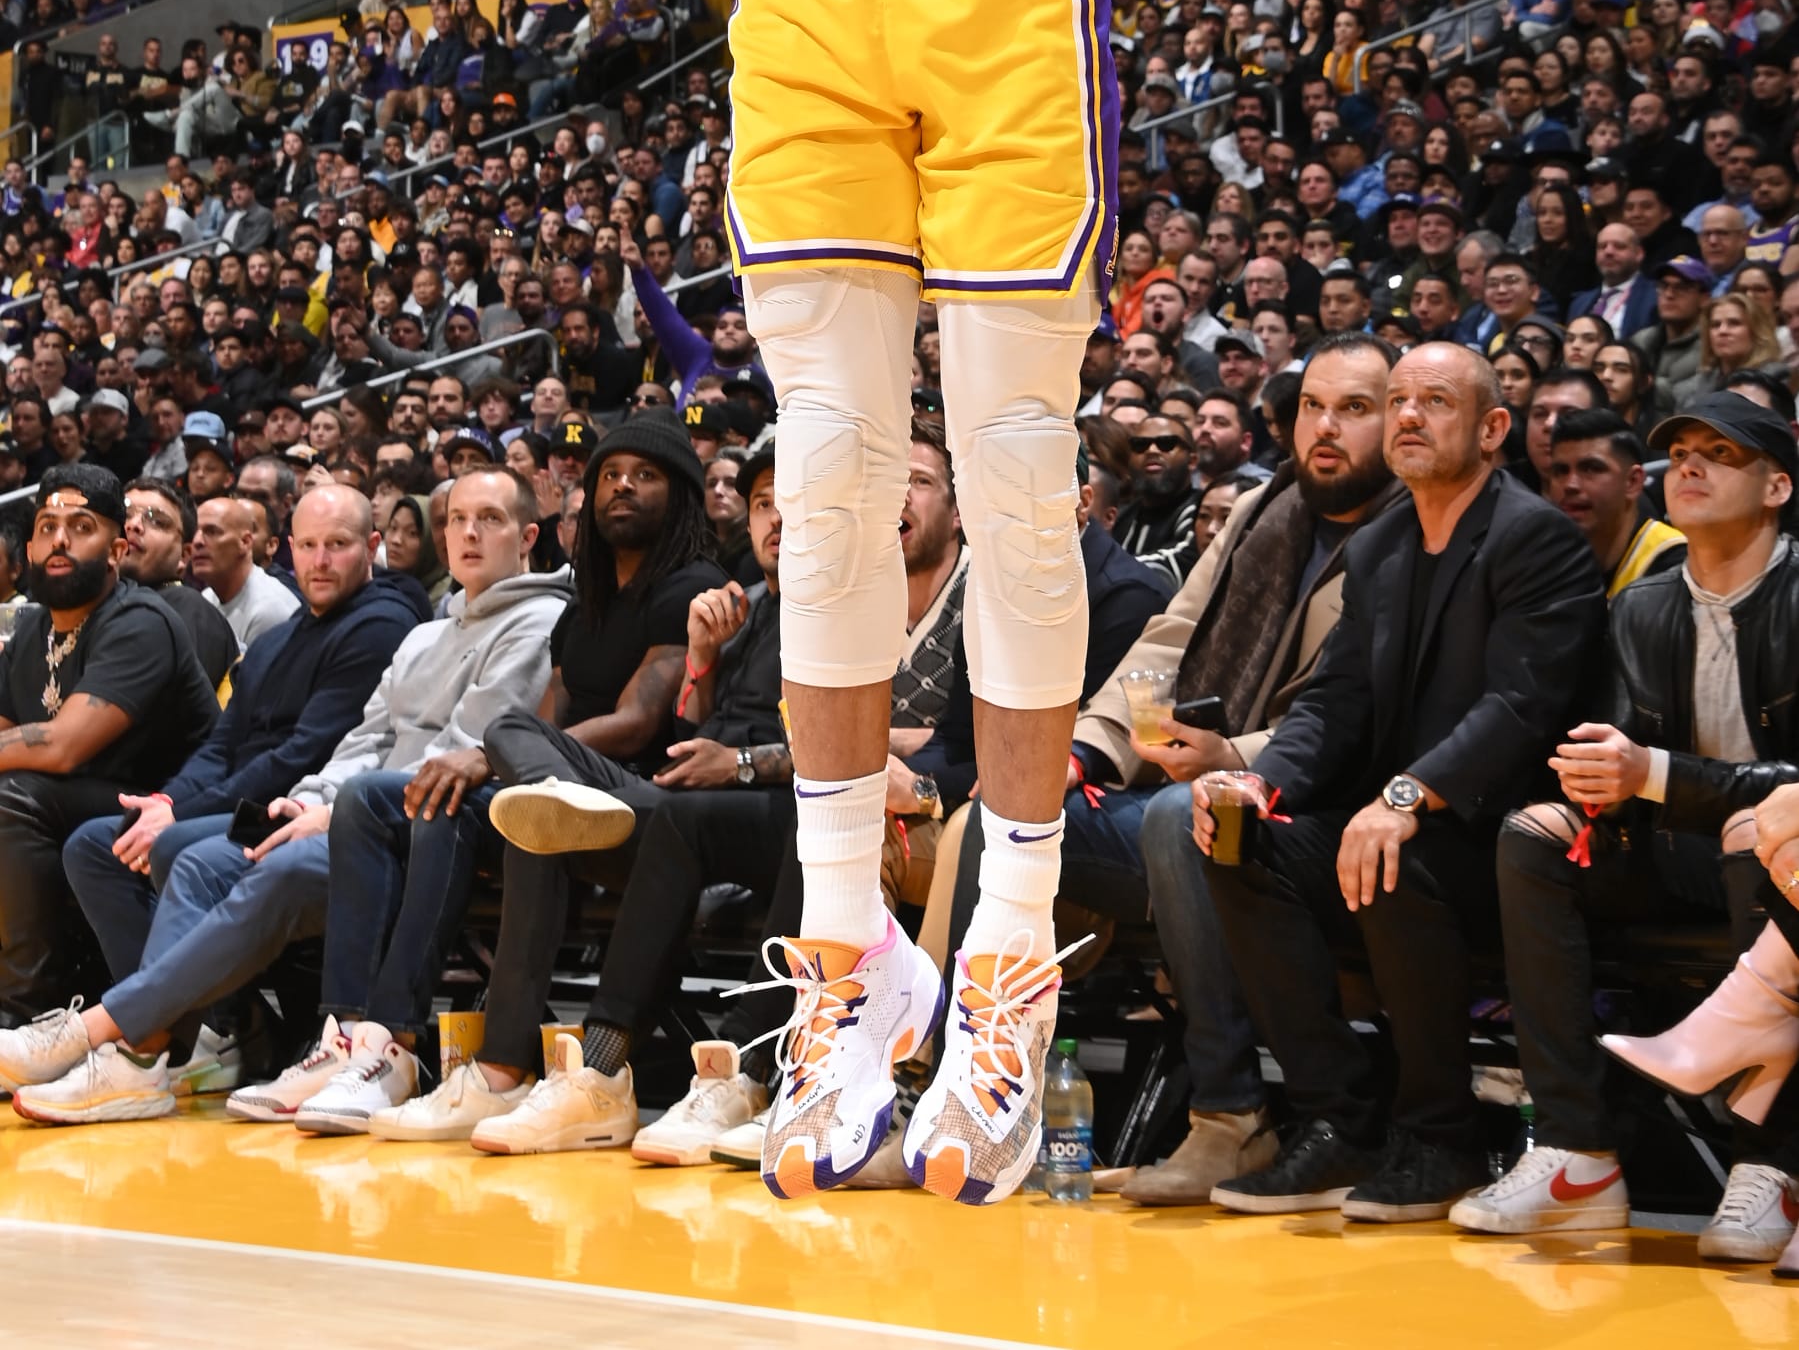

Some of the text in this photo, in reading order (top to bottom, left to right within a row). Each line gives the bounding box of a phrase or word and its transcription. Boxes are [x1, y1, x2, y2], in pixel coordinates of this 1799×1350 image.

[280, 38, 329, 75] 19
[685, 406, 704, 425] N
[564, 424, 584, 444] K
